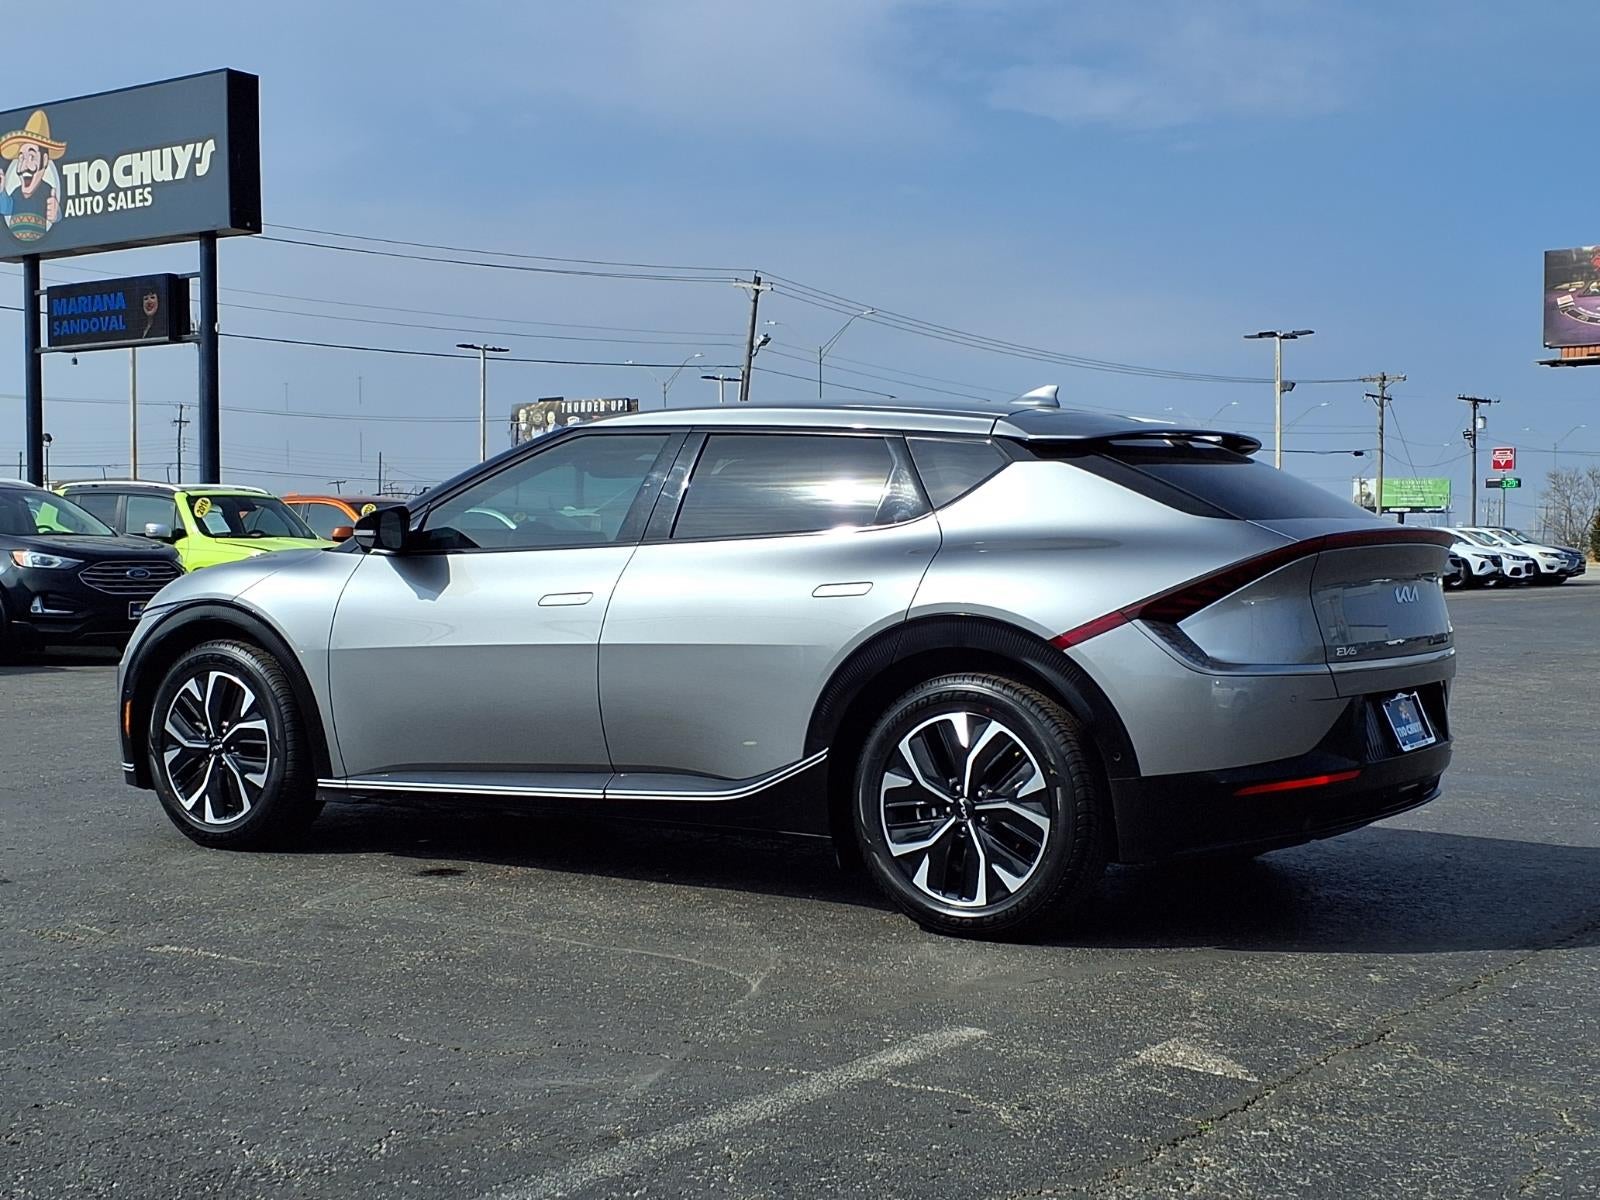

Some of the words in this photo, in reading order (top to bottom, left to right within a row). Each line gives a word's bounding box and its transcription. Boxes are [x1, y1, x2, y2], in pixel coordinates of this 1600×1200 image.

[62, 158, 111, 196] TIO
[113, 138, 216, 188] CHUY'S
[64, 195, 104, 218] AUTO
[107, 187, 153, 212] SALES
[53, 292, 128, 316] MARIANA
[53, 315, 127, 337] SANDOVAL
[561, 400, 605, 413] THUNDER
[610, 400, 628, 411] UP!
[196, 499, 209, 515] 2018
[1394, 585, 1419, 603] KIA
[1336, 647, 1357, 656] EV6
